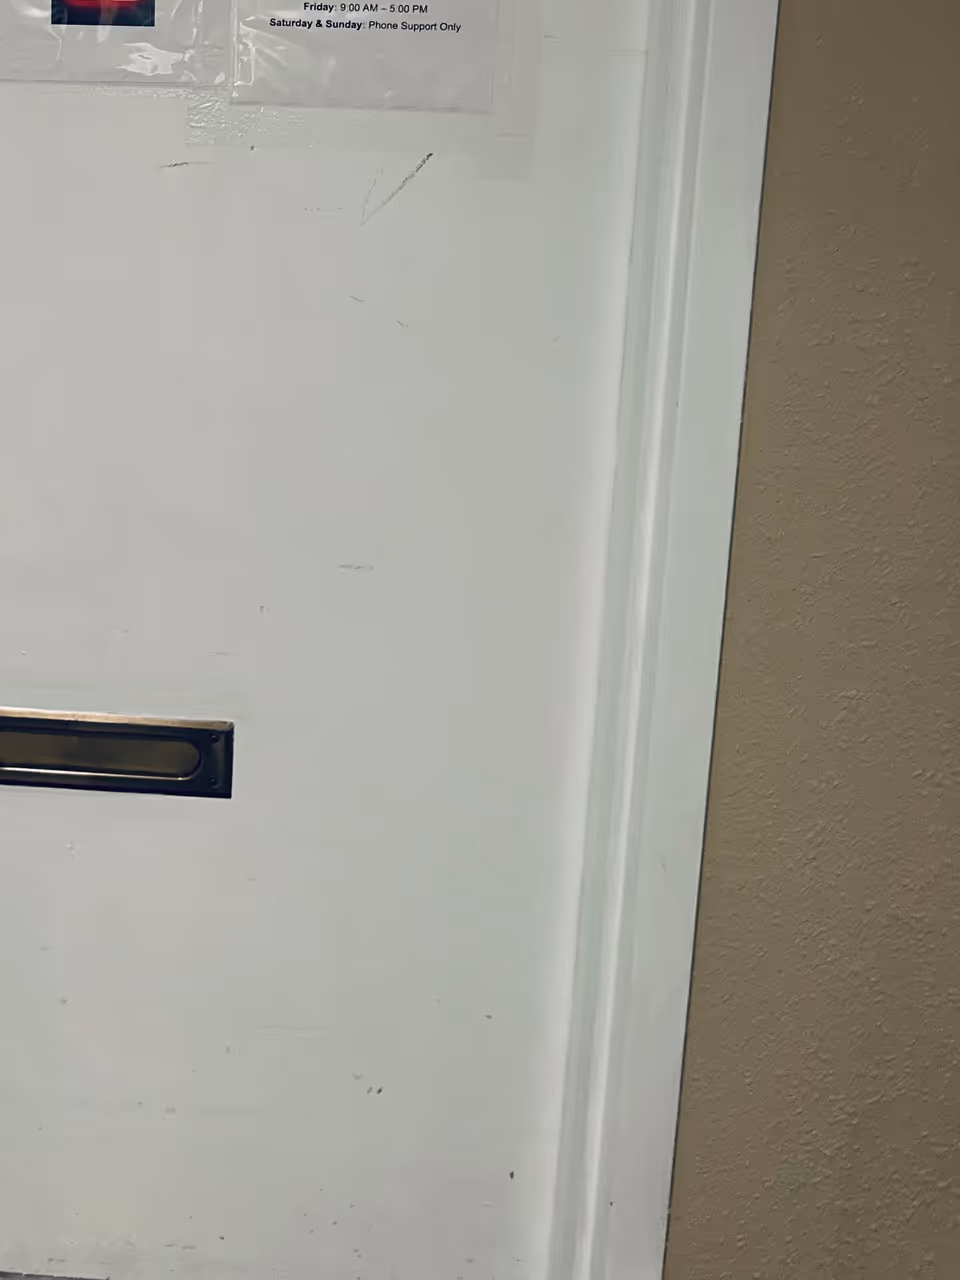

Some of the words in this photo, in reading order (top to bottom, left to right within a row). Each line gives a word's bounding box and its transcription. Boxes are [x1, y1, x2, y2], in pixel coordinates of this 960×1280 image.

[303, 3, 337, 13] Friday:
[340, 4, 360, 12] 9:00
[362, 4, 378, 13] AM
[390, 5, 410, 13] 5:00
[412, 5, 428, 14] PM
[270, 19, 313, 30] Saturday
[316, 20, 322, 28] &
[325, 20, 365, 30] Sunday:
[369, 21, 398, 30] Phone
[401, 22, 437, 32] Support
[440, 23, 461, 33] Only
